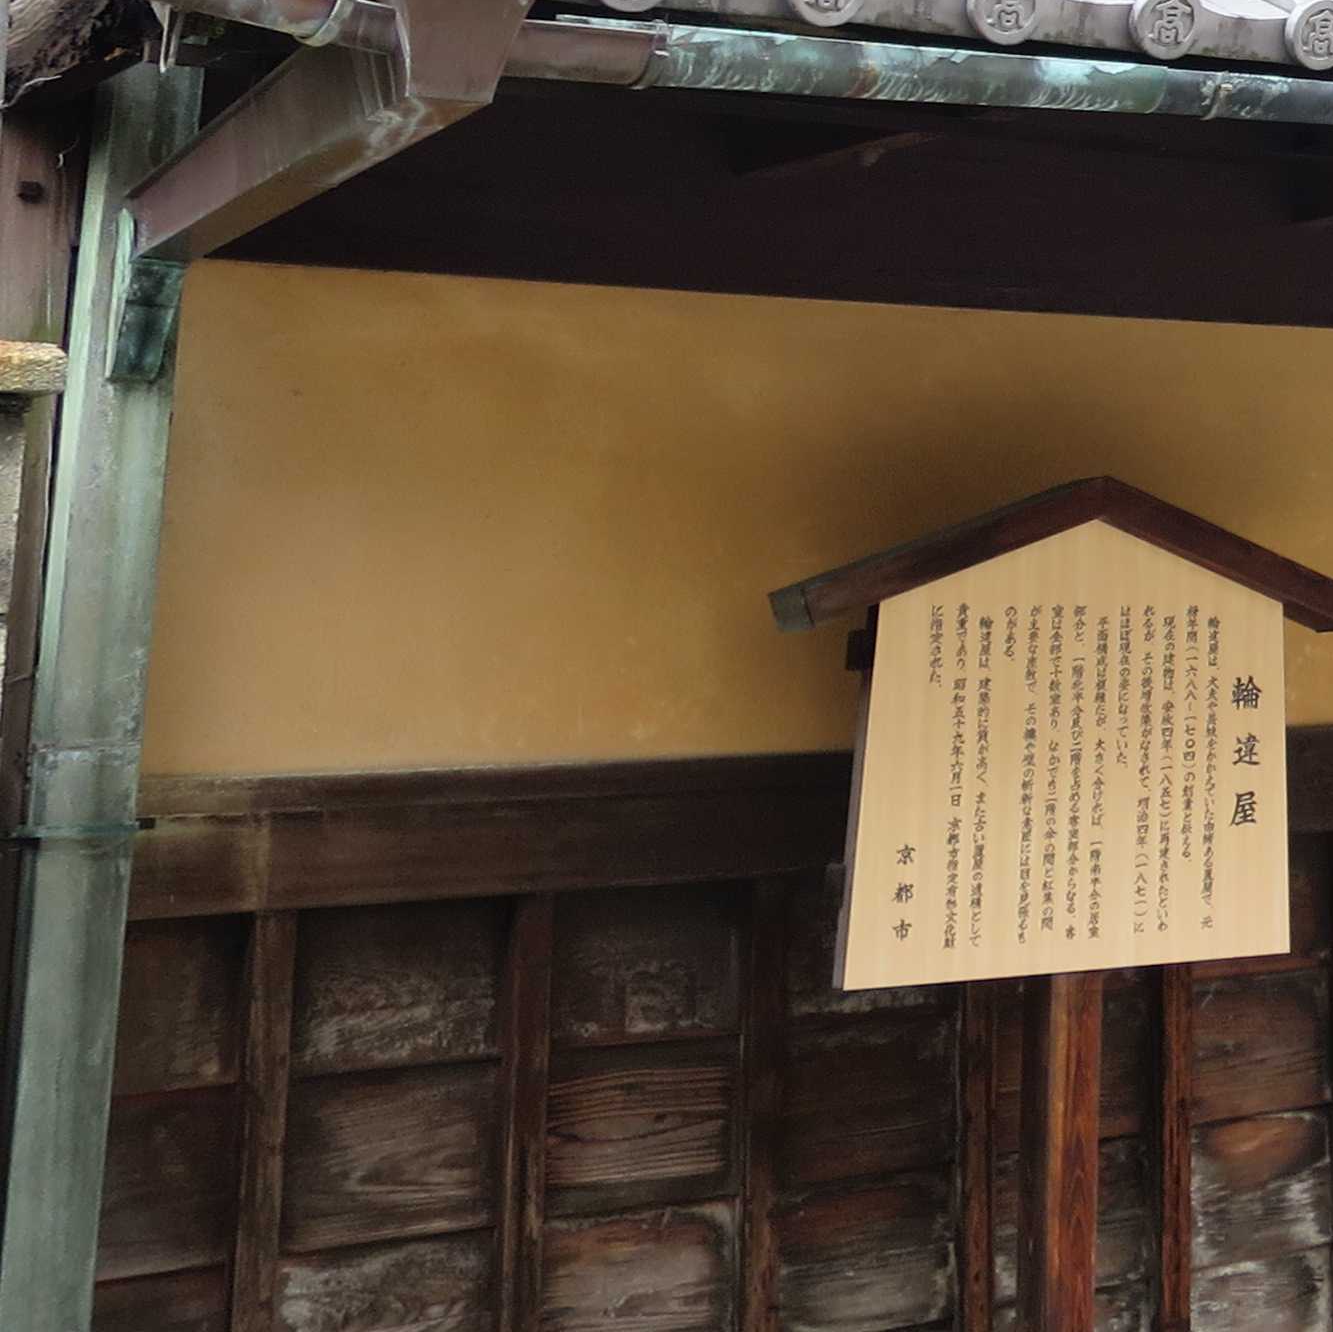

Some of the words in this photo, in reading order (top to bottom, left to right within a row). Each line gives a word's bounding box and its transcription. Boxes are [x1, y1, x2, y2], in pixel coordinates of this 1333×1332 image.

[928, 604, 944, 688] に指定された。
[1228, 674, 1265, 827] 輪違屋
[890, 843, 917, 942] 京都市
